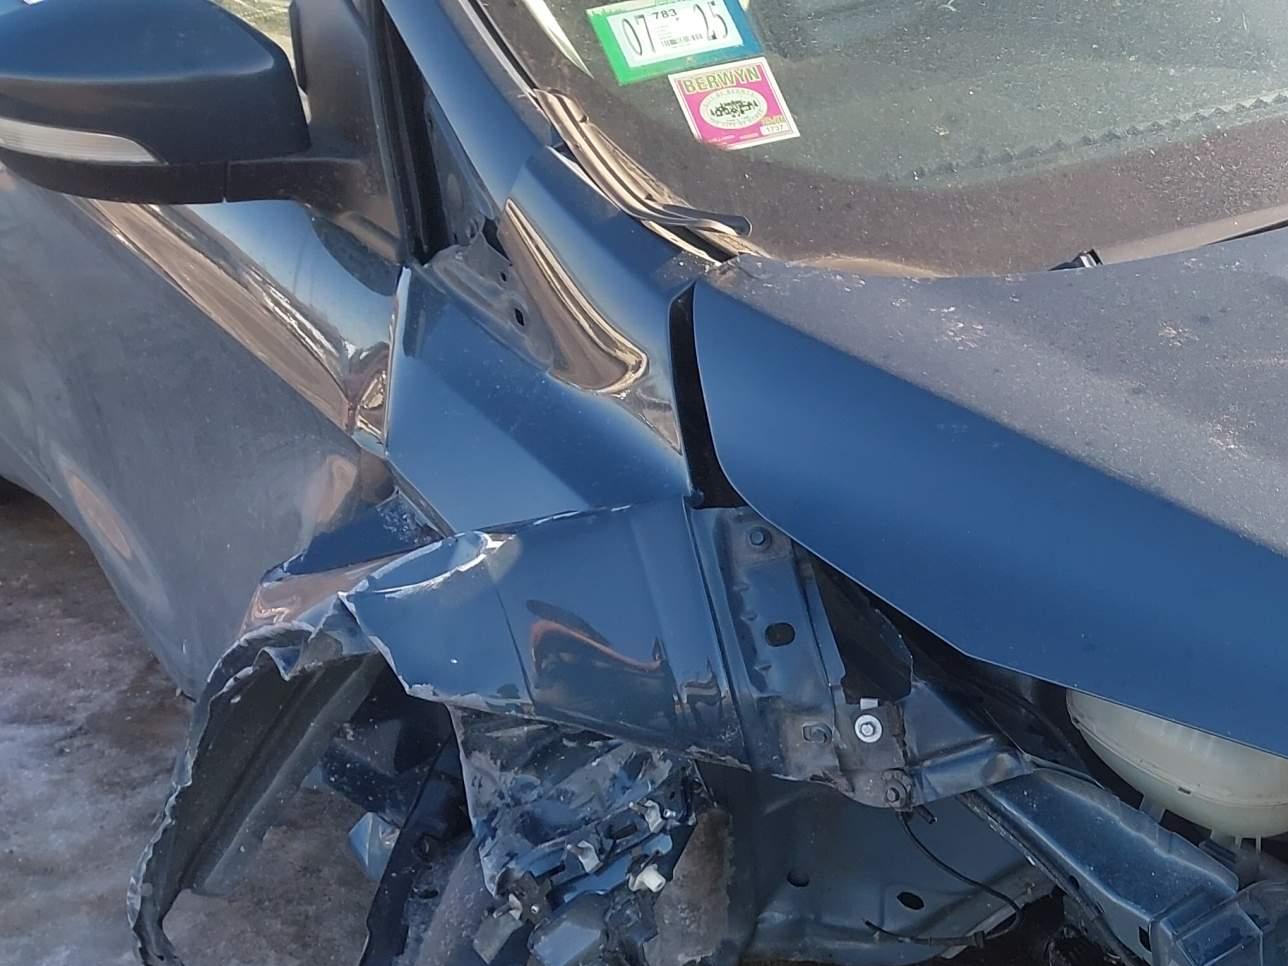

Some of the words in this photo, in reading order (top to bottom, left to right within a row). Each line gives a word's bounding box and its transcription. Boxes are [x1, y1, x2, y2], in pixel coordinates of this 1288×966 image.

[621, 14, 657, 56] 07
[692, 0, 729, 42] 25
[651, 8, 678, 20] 783
[683, 66, 760, 94] BERWYN
